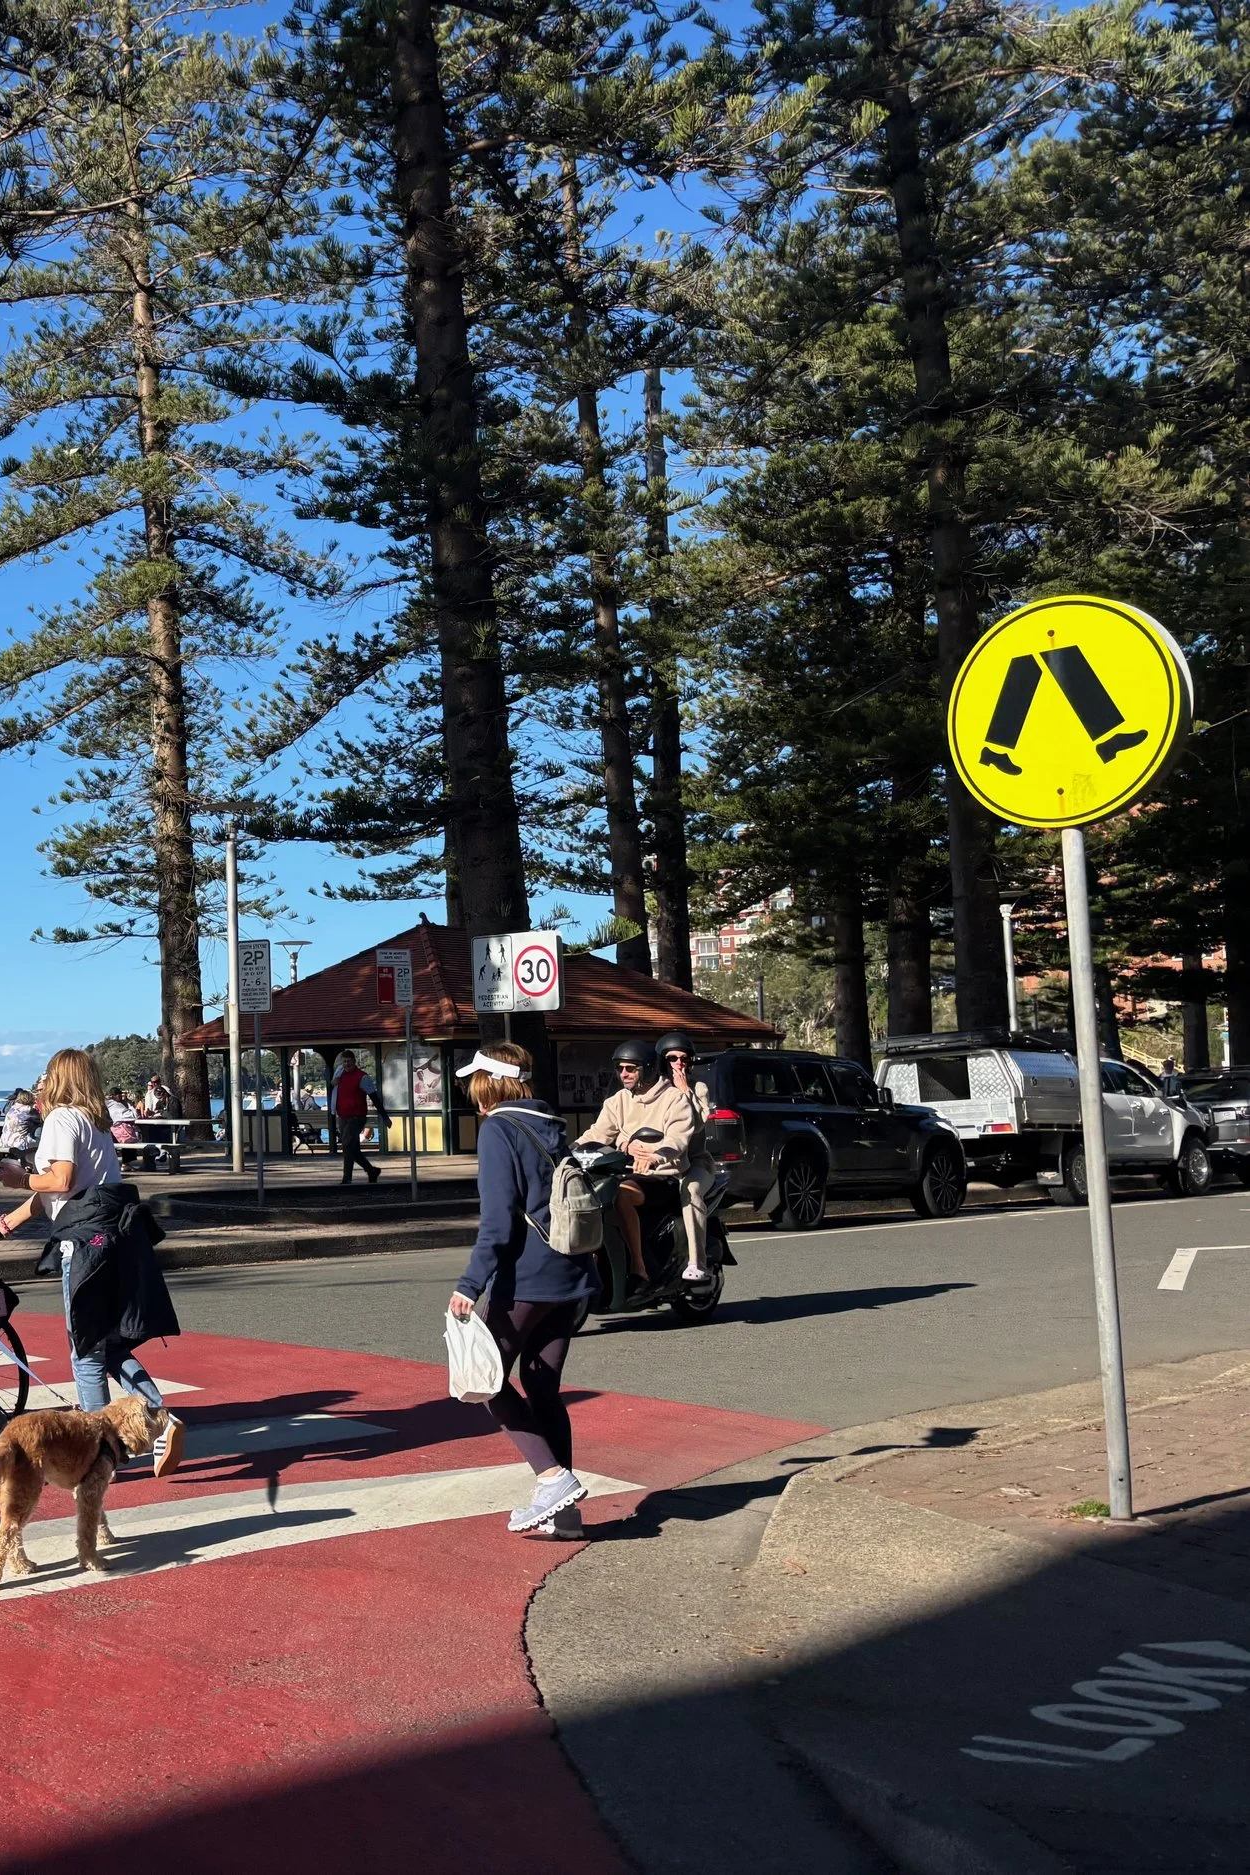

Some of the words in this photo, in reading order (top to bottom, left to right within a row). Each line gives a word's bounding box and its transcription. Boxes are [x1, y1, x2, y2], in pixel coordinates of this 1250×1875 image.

[243, 950, 264, 966] 2P
[397, 968, 410, 978] 2P
[521, 958, 550, 983] 30
